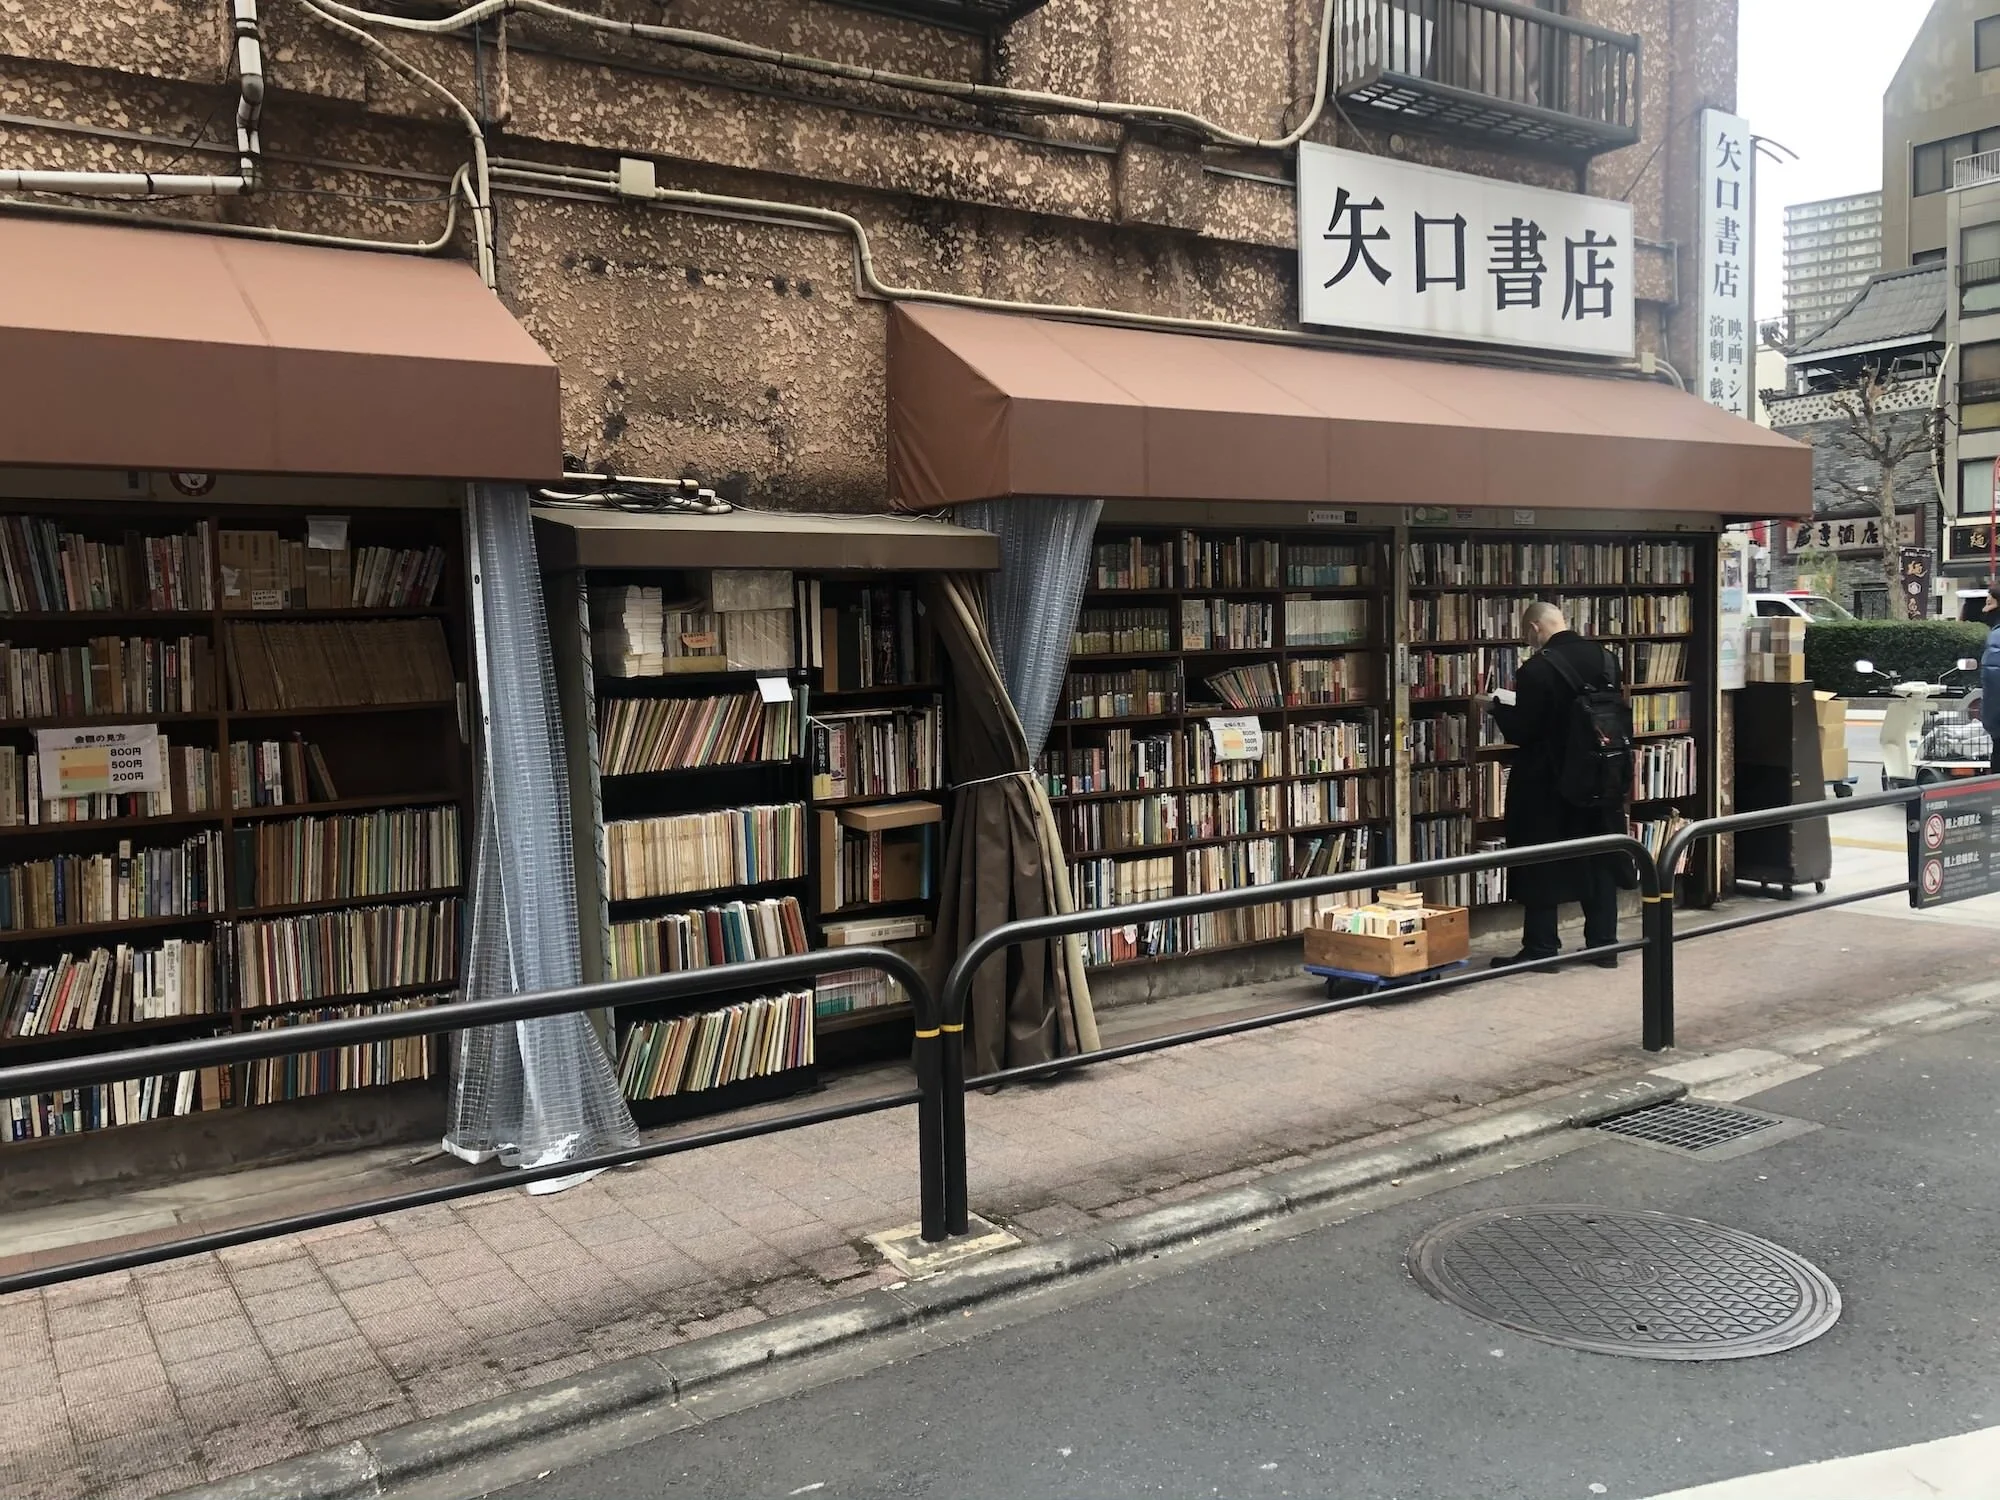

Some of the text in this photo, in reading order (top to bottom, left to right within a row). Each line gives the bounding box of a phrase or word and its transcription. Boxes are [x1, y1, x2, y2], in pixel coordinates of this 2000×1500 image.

[1713, 131, 1742, 299] 矢口書店
[1323, 187, 1618, 321] 矢口書店
[74, 733, 126, 744] 金額の見方
[110, 747, 142, 757] 800円
[111, 759, 143, 769] 500円
[112, 771, 144, 782] 200円
